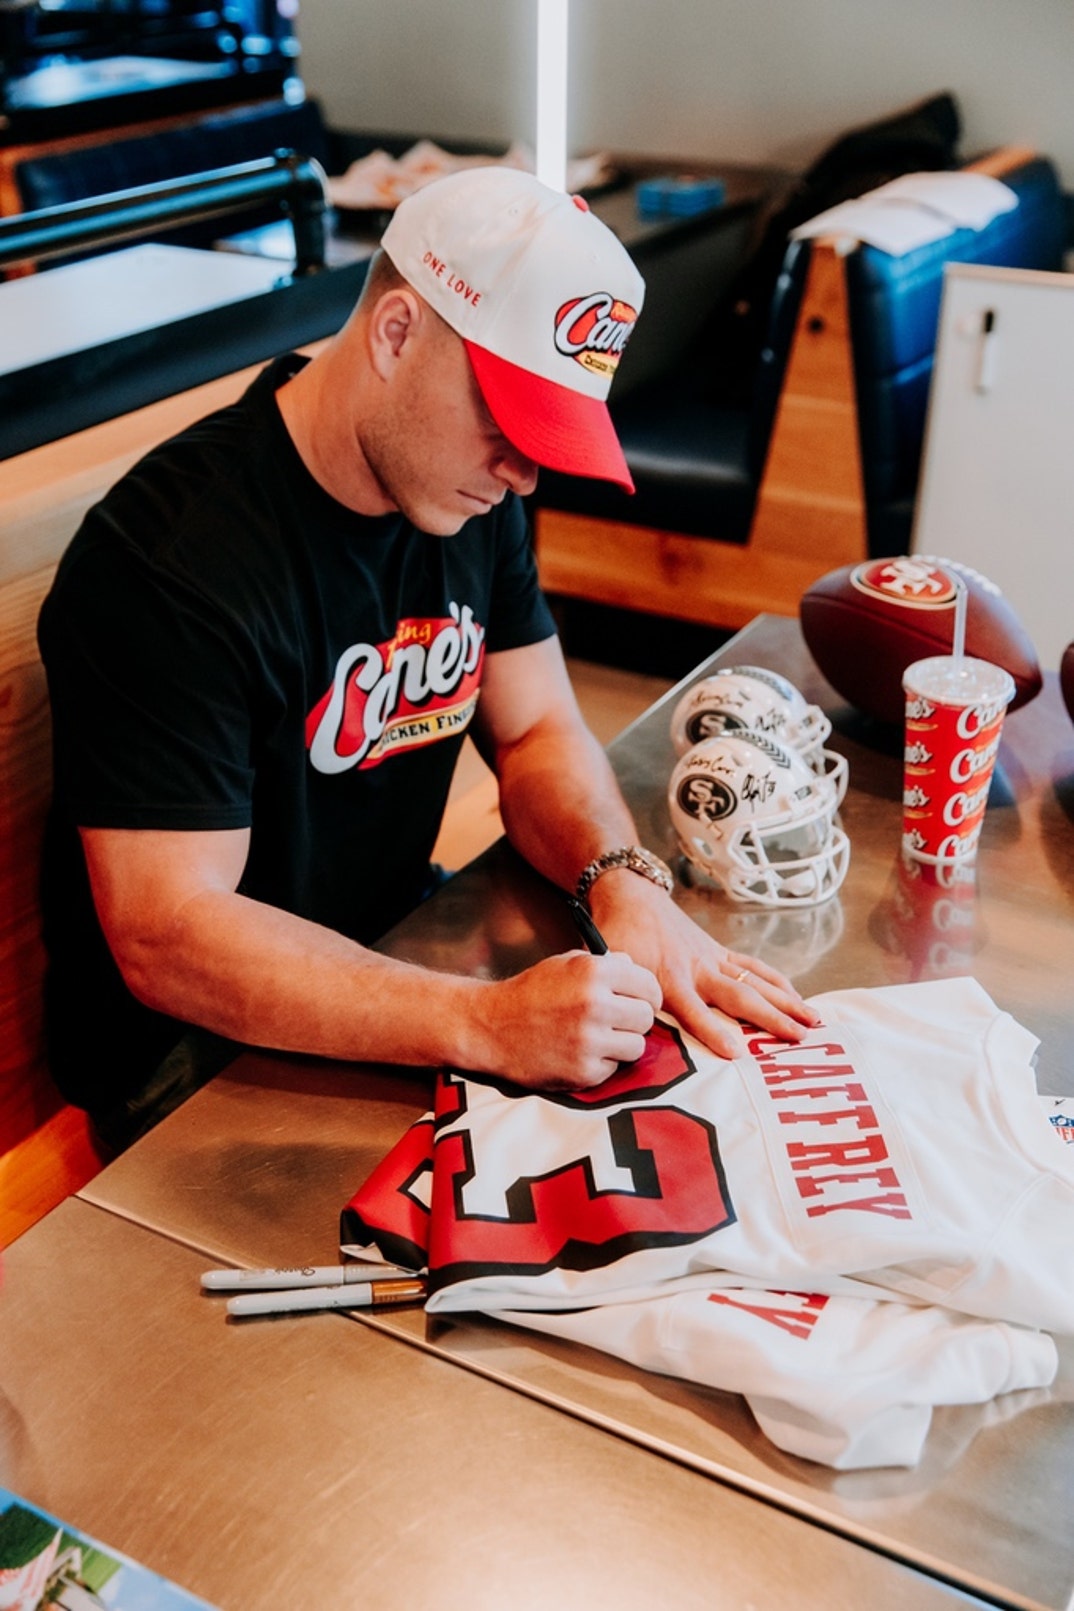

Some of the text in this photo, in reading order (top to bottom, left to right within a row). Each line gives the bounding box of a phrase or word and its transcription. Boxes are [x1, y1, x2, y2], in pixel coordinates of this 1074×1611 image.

[422, 251, 482, 307] ONE LOVE
[310, 601, 485, 775] Cane's
